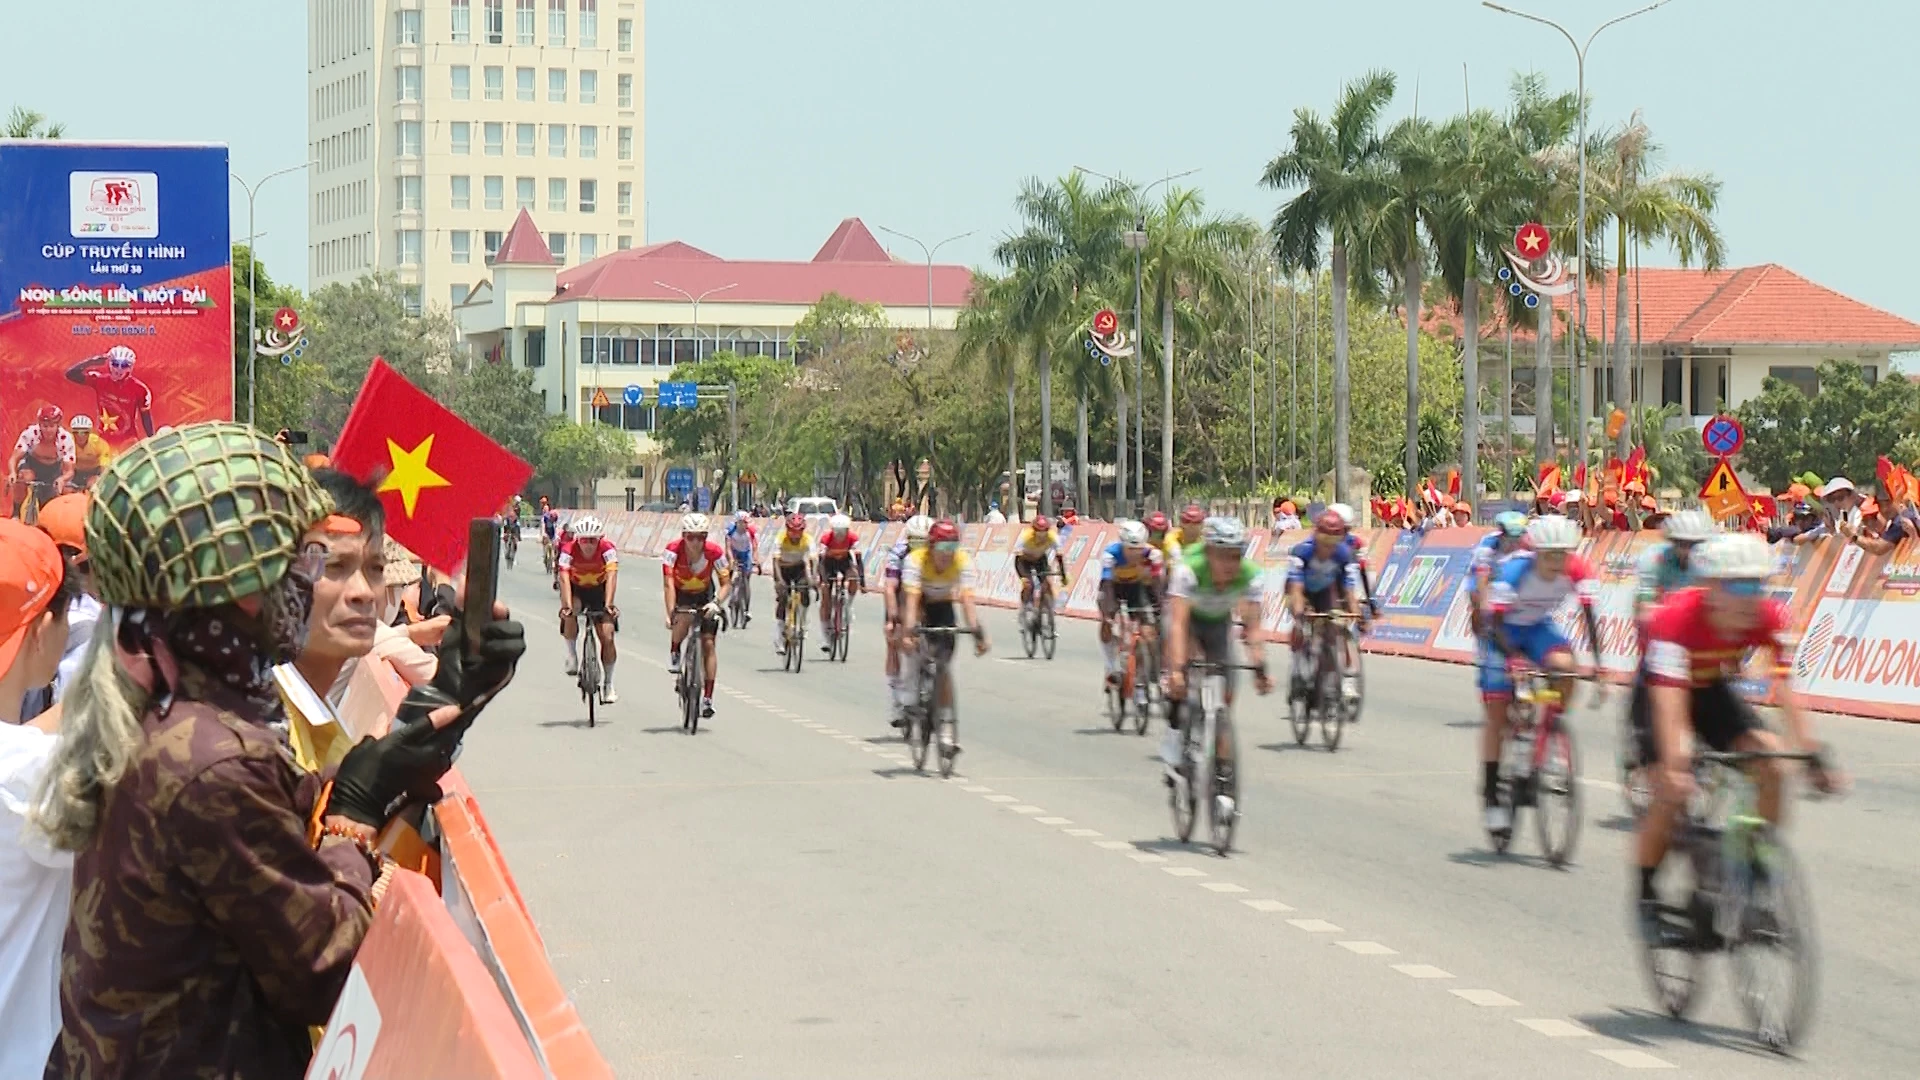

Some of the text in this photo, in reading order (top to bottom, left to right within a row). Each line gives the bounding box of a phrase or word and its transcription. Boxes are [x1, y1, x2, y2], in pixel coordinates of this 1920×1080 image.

[79, 241, 143, 258] TRUYỀN
[147, 243, 185, 258] HÌNH
[20, 287, 55, 302] NON
[60, 285, 102, 305] SÔNG
[107, 283, 138, 302] LIỀN
[143, 285, 177, 306] MỘT
[1821, 635, 1876, 683] TON
